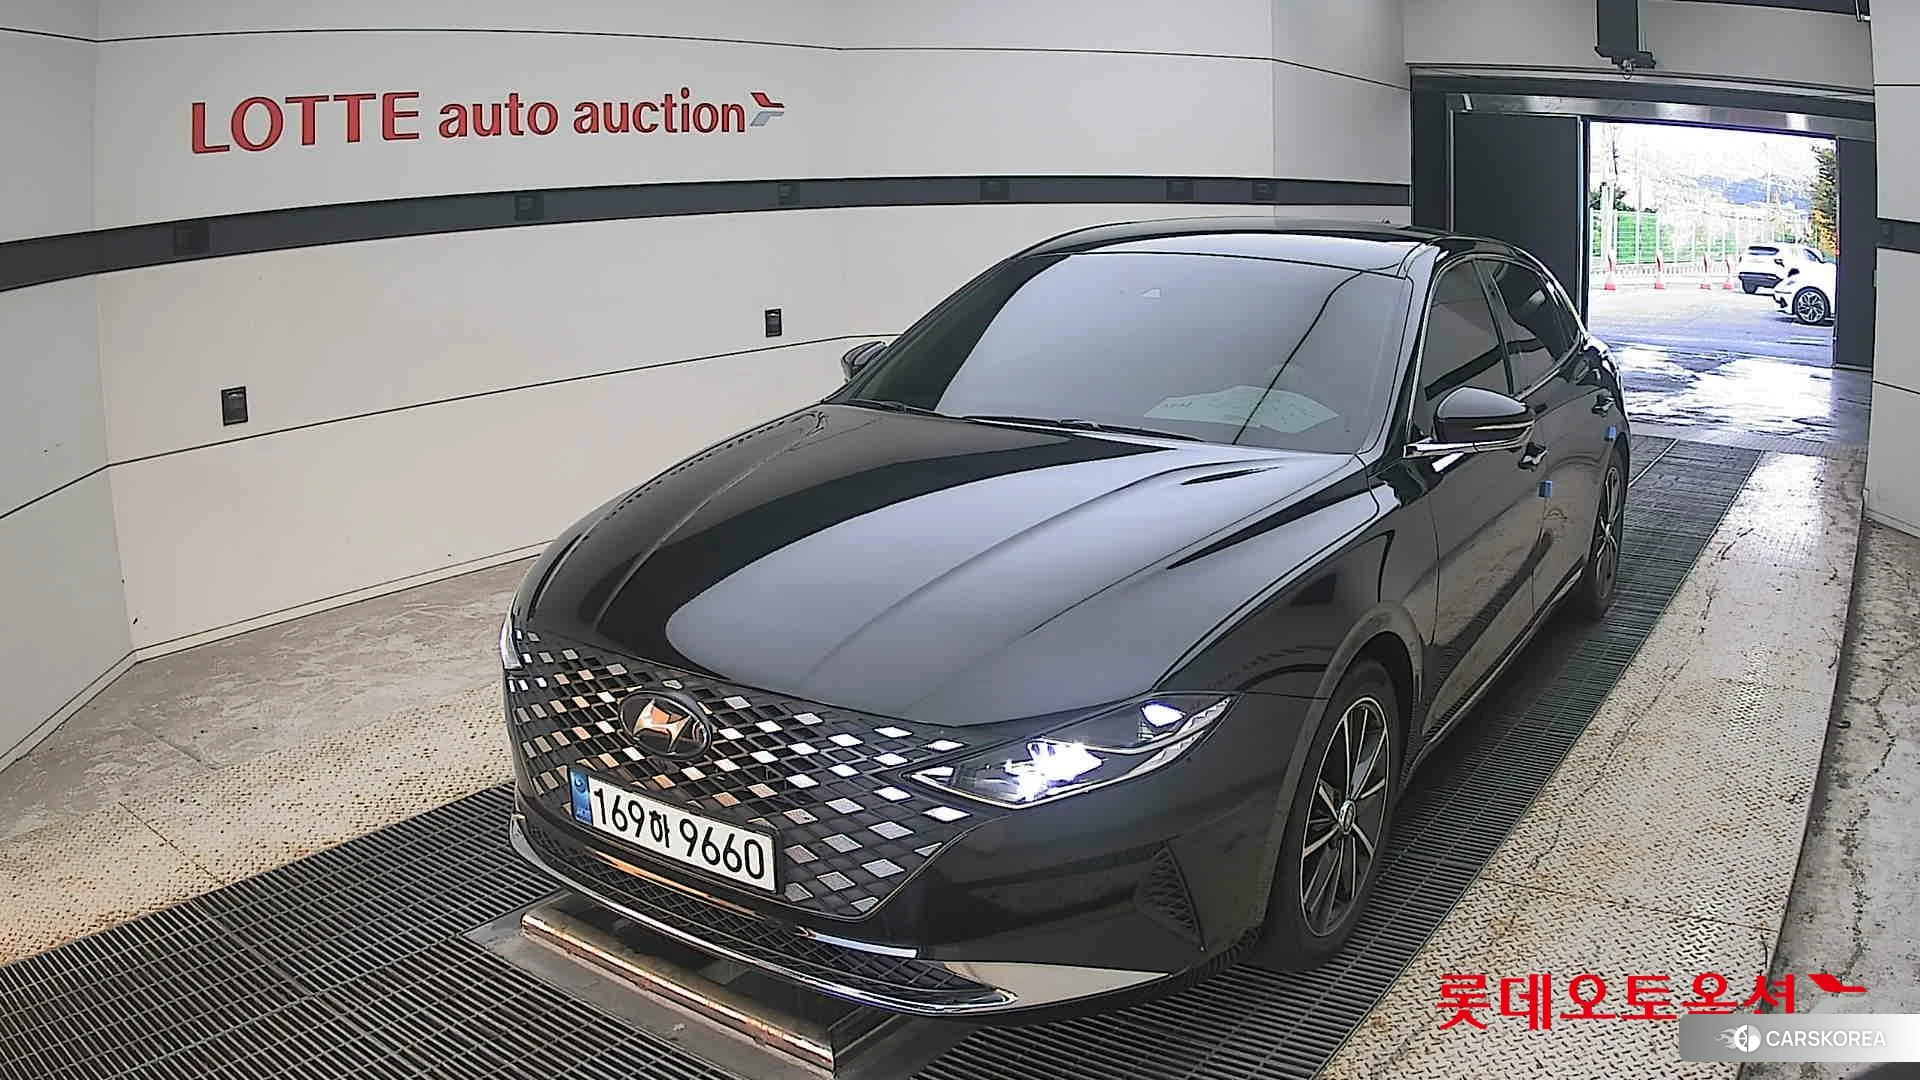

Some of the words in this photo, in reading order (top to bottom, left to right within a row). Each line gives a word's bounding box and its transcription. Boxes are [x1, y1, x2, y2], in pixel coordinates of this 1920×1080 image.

[191, 91, 420, 155] LOTTE
[438, 92, 560, 138] auto
[573, 87, 746, 134] auction
[593, 787, 670, 848] 169하
[679, 818, 765, 880] 9660
